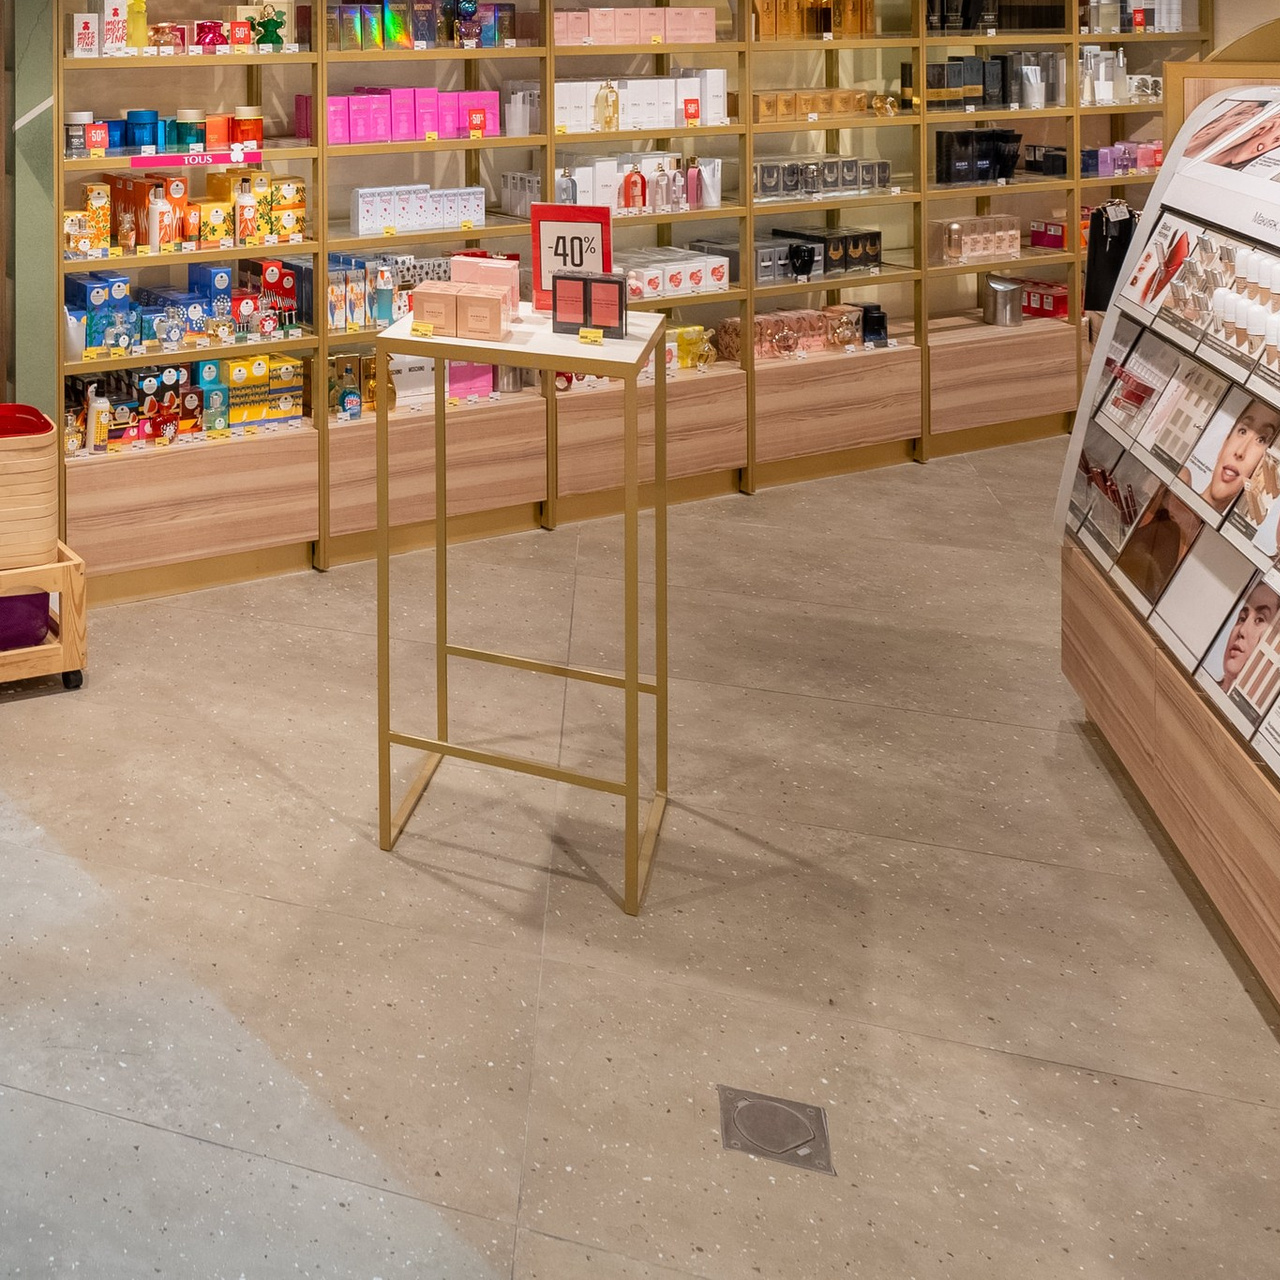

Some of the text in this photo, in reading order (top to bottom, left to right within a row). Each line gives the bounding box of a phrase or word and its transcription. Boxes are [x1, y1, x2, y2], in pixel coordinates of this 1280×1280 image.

[104, 33, 128, 44] PINK
[183, 154, 213, 165] TOUS
[548, 236, 596, 268] -40%
